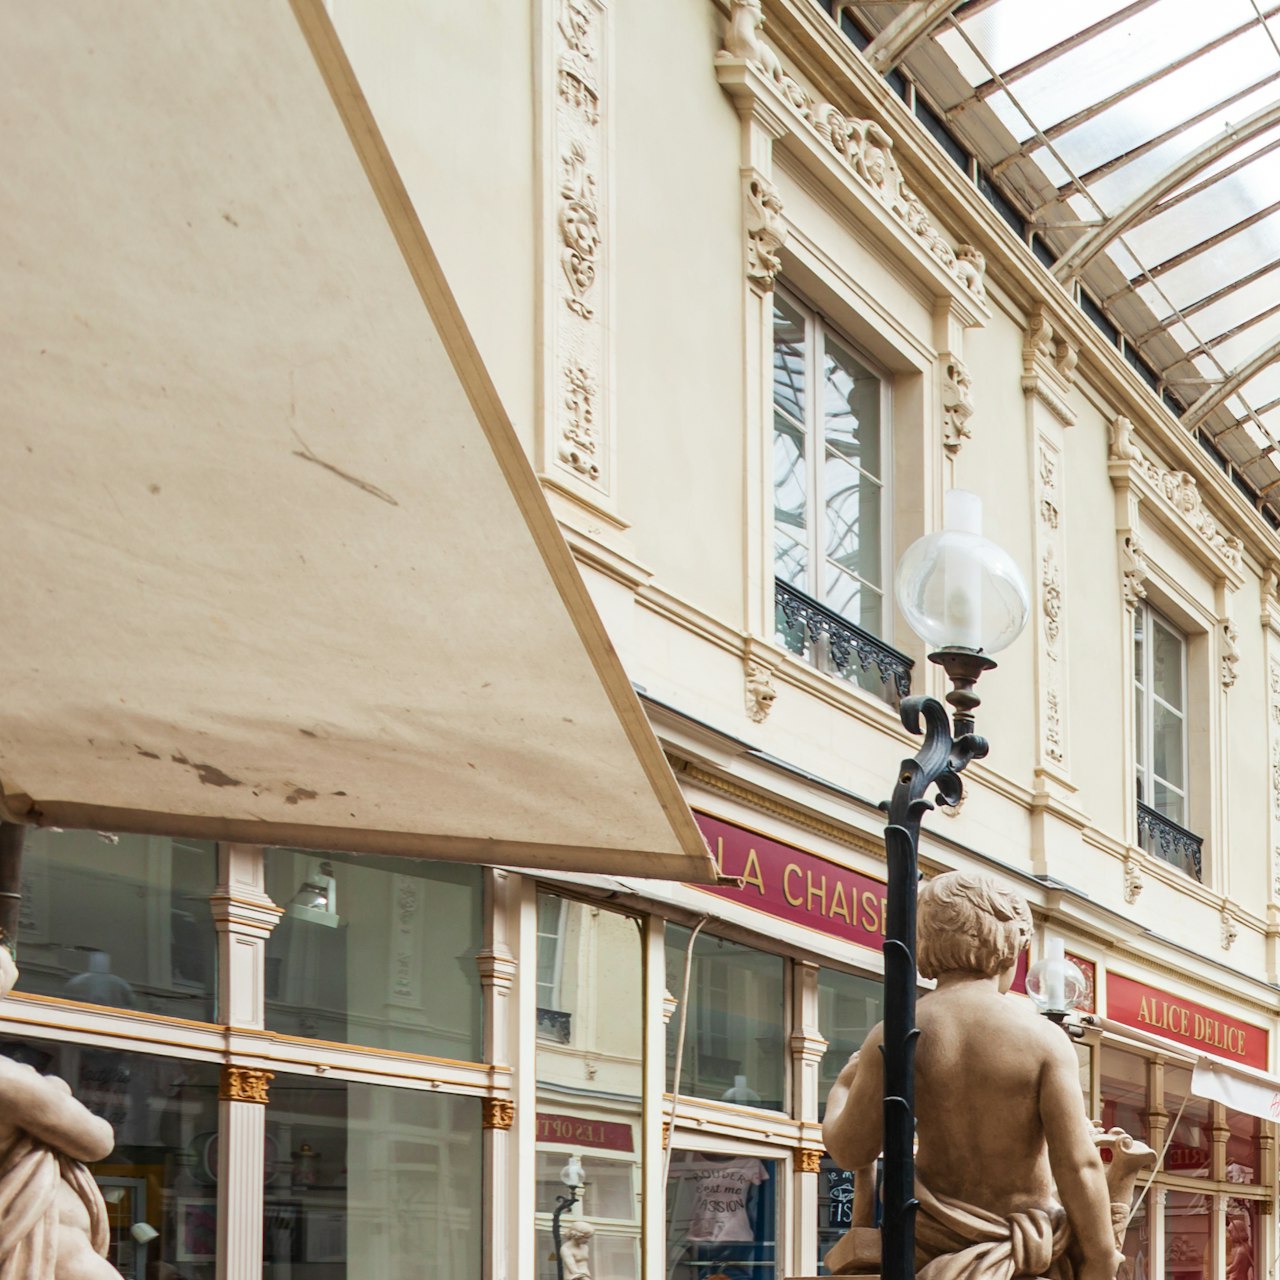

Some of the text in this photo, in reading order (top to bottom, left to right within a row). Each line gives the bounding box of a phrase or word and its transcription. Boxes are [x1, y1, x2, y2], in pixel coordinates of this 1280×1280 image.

[717, 836, 766, 895] LA
[1137, 995, 1246, 1056] ALICE DELICE
